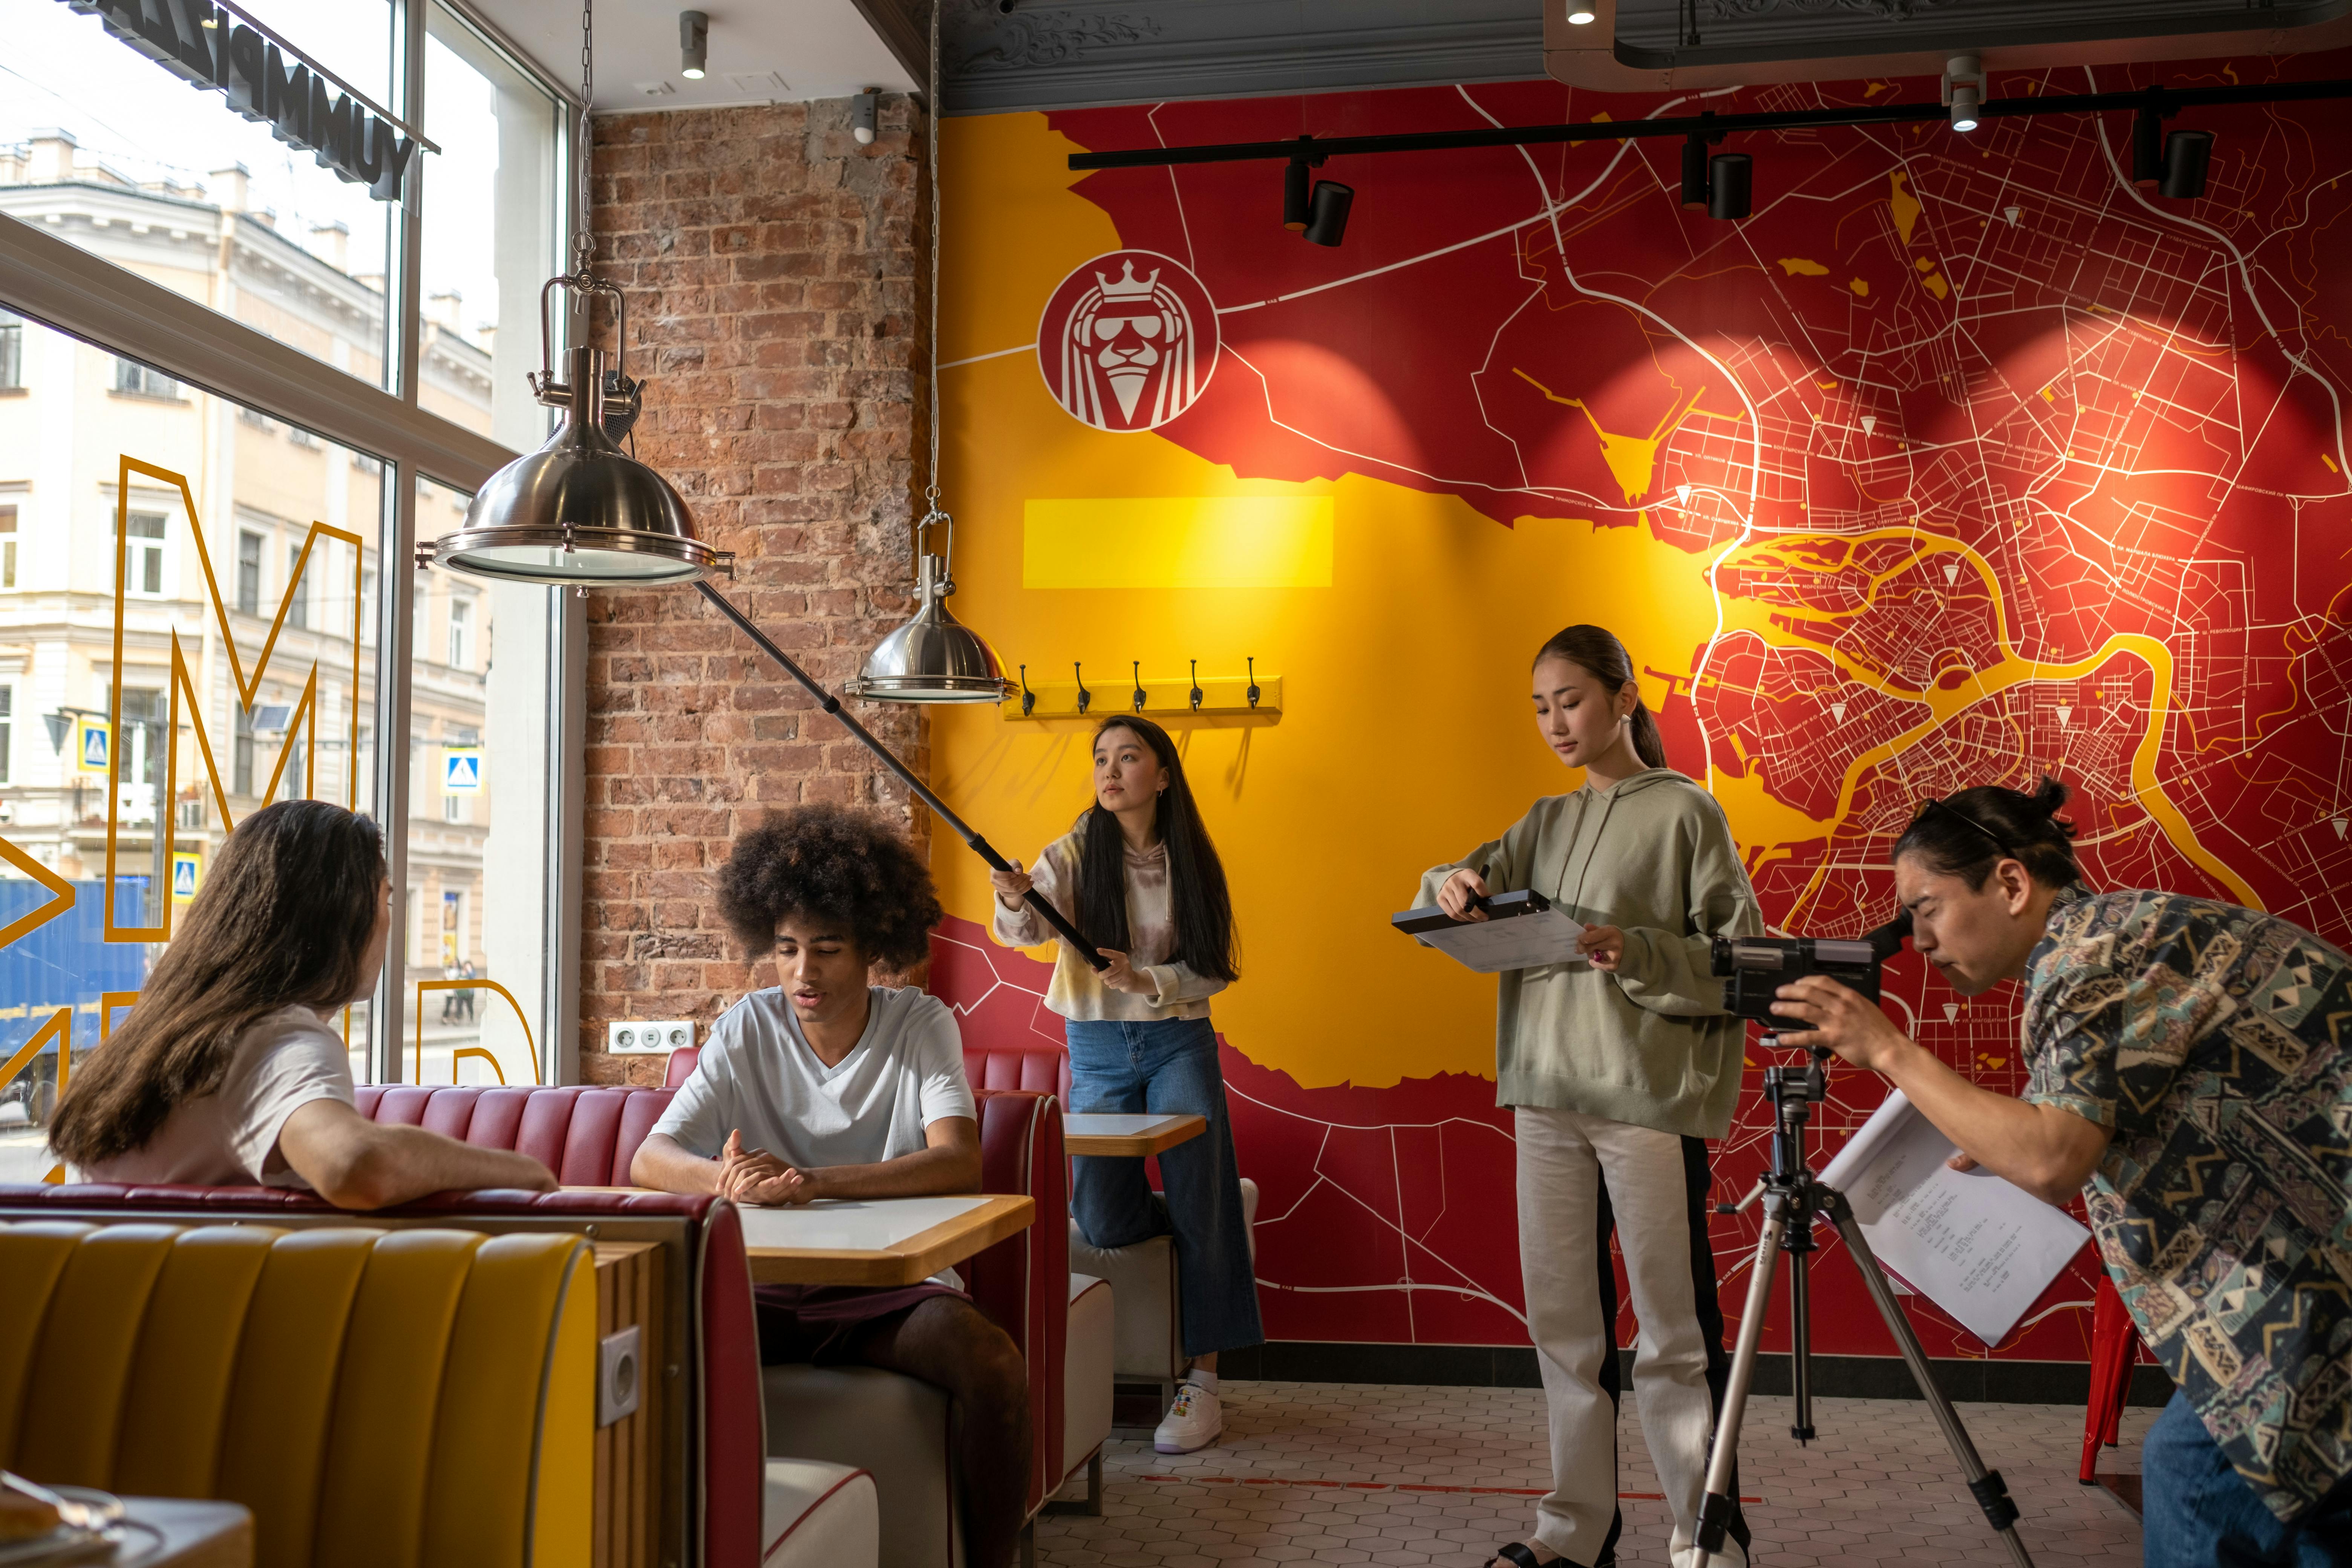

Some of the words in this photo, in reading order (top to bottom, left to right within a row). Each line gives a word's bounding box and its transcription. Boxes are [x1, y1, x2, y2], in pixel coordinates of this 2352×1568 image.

[2165, 233, 2202, 249] СУЗДАЛЬСКИЙ
[2127, 328, 2152, 343] СЕВЕРНЫЙ
[2275, 338, 2284, 349] КАД
[1703, 455, 1726, 464] ОПТИКОВ
[2236, 484, 2276, 496] ШАФИРОВСКИЙ
[1555, 496, 1588, 507] ПРИМОРСКОЕ
[1877, 515, 1907, 525] САВУШКИНА
[2125, 547, 2151, 557] МАРШАЛА
[2151, 552, 2176, 562] БЛЮХЕРА
[2121, 587, 2165, 611] ПОЛЮСТРОВСКИЙ
[2209, 626, 2242, 635] РЕВОЛЮЦИИ
[2315, 643, 2344, 685] ИНДУСТРИАЛЬНЫЙ
[2308, 702, 2335, 717] КОСЫГИНА
[2026, 753, 2050, 764] НЕВСКИЙ
[2178, 764, 2208, 779] ЗАНЕВСКИЙ
[2283, 821, 2314, 838] КОЛЛОНТАЙ
[2250, 847, 2294, 883] ДАЛЬНЕВОСТОЧНЫЙ
[2326, 881, 2350, 894] ДЫБЕНКО
